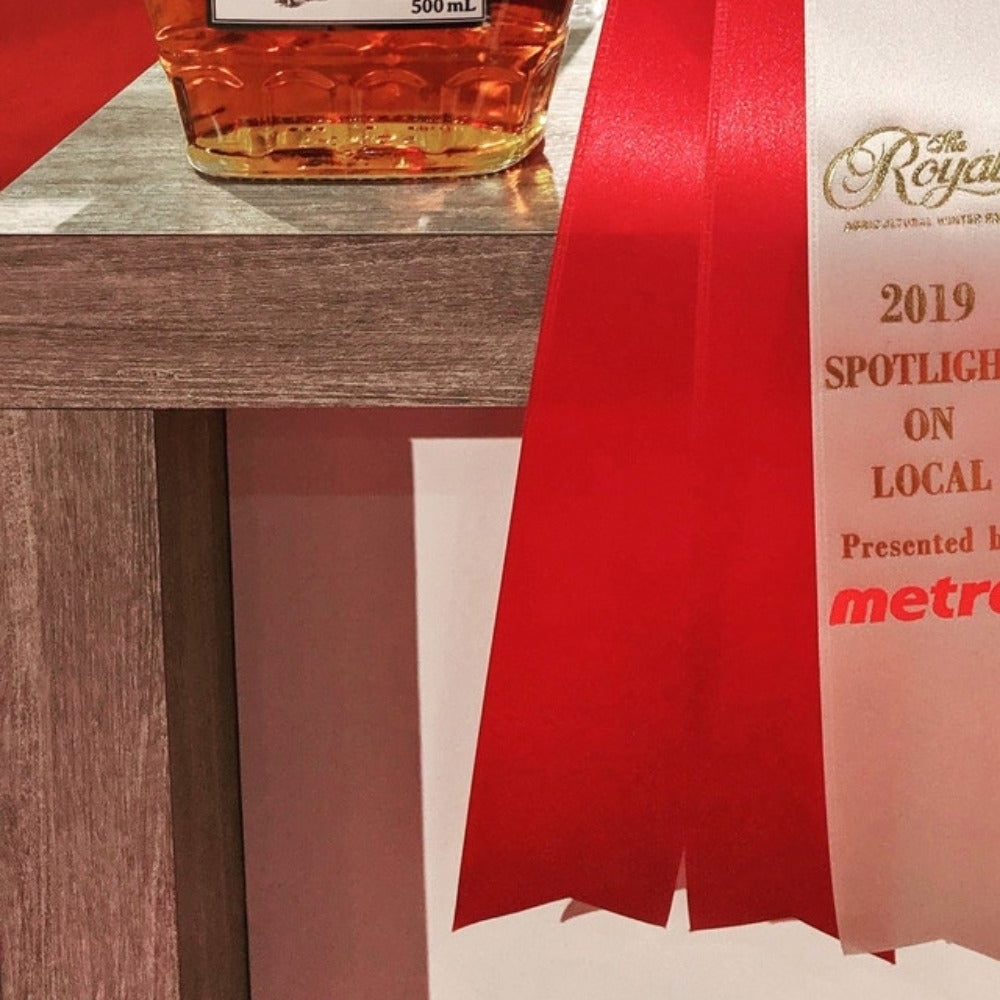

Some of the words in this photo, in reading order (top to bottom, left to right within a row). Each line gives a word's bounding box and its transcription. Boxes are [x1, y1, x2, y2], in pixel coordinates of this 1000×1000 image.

[411, 0, 444, 14] 500
[880, 281, 977, 325] 2019
[903, 406, 956, 442] ON
[870, 459, 993, 499] LOCAL
[841, 526, 974, 559] Presented
